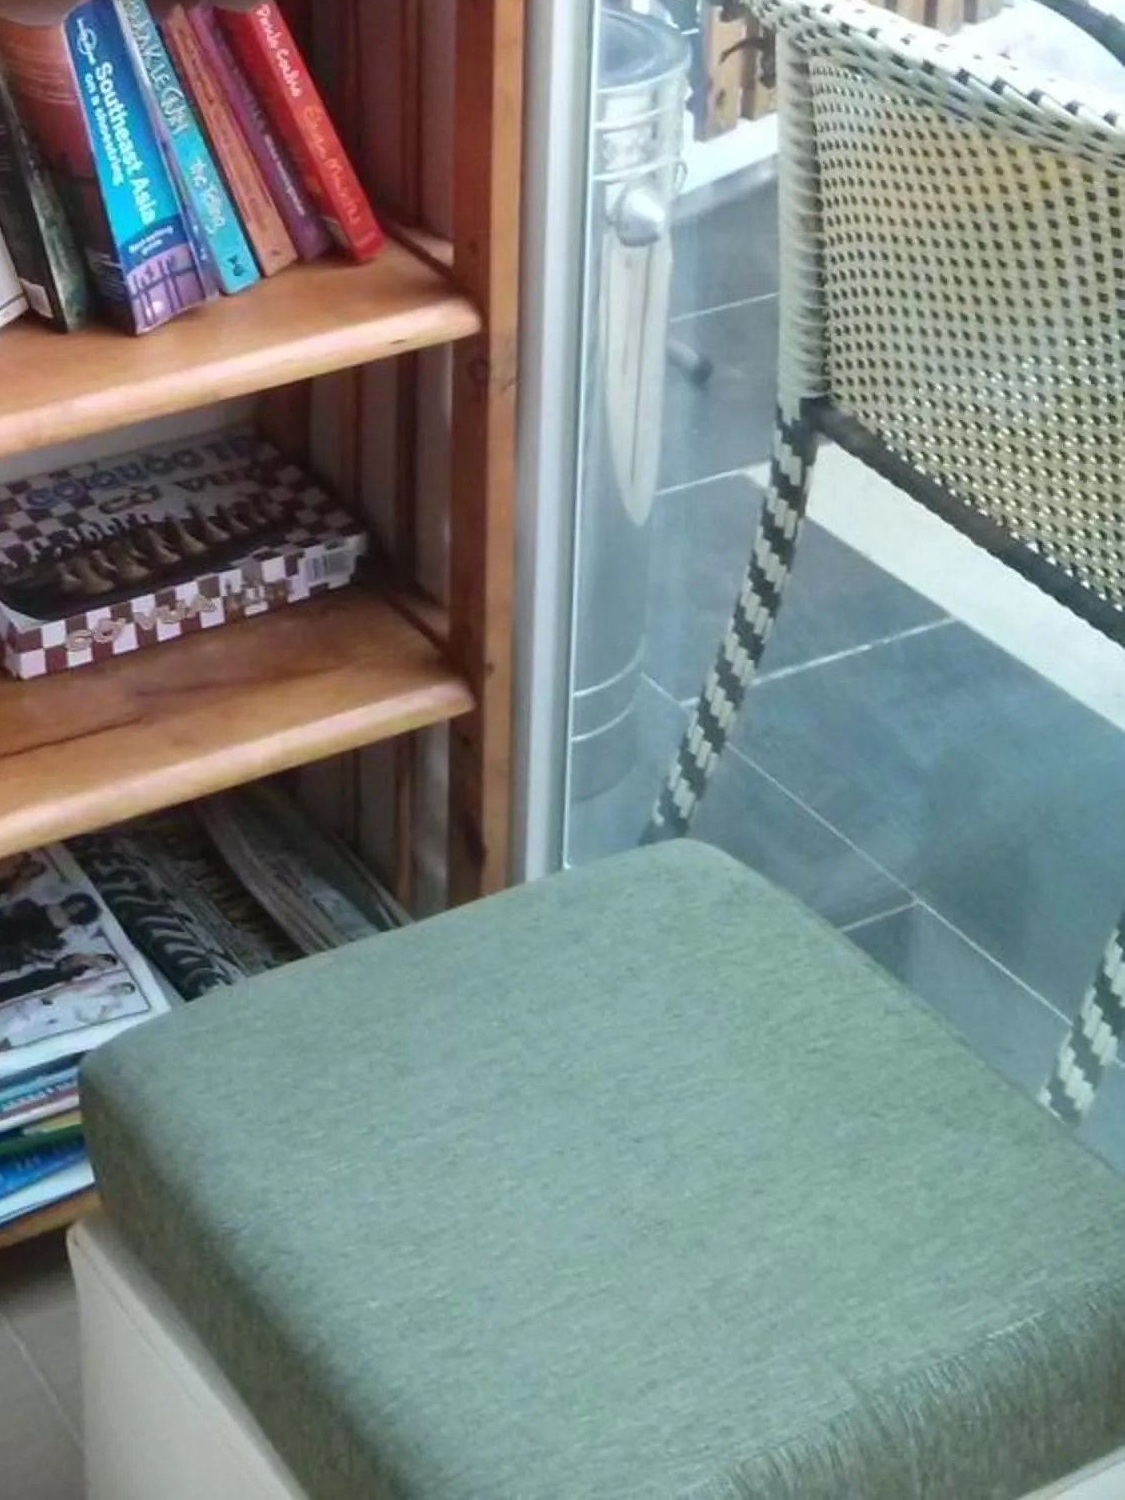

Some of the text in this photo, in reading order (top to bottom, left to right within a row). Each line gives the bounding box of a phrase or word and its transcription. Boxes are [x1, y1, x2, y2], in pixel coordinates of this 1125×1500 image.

[81, 71, 98, 93] on
[89, 106, 127, 187] shoestring
[91, 59, 146, 175] Southeast
[128, 174, 162, 226] Asia
